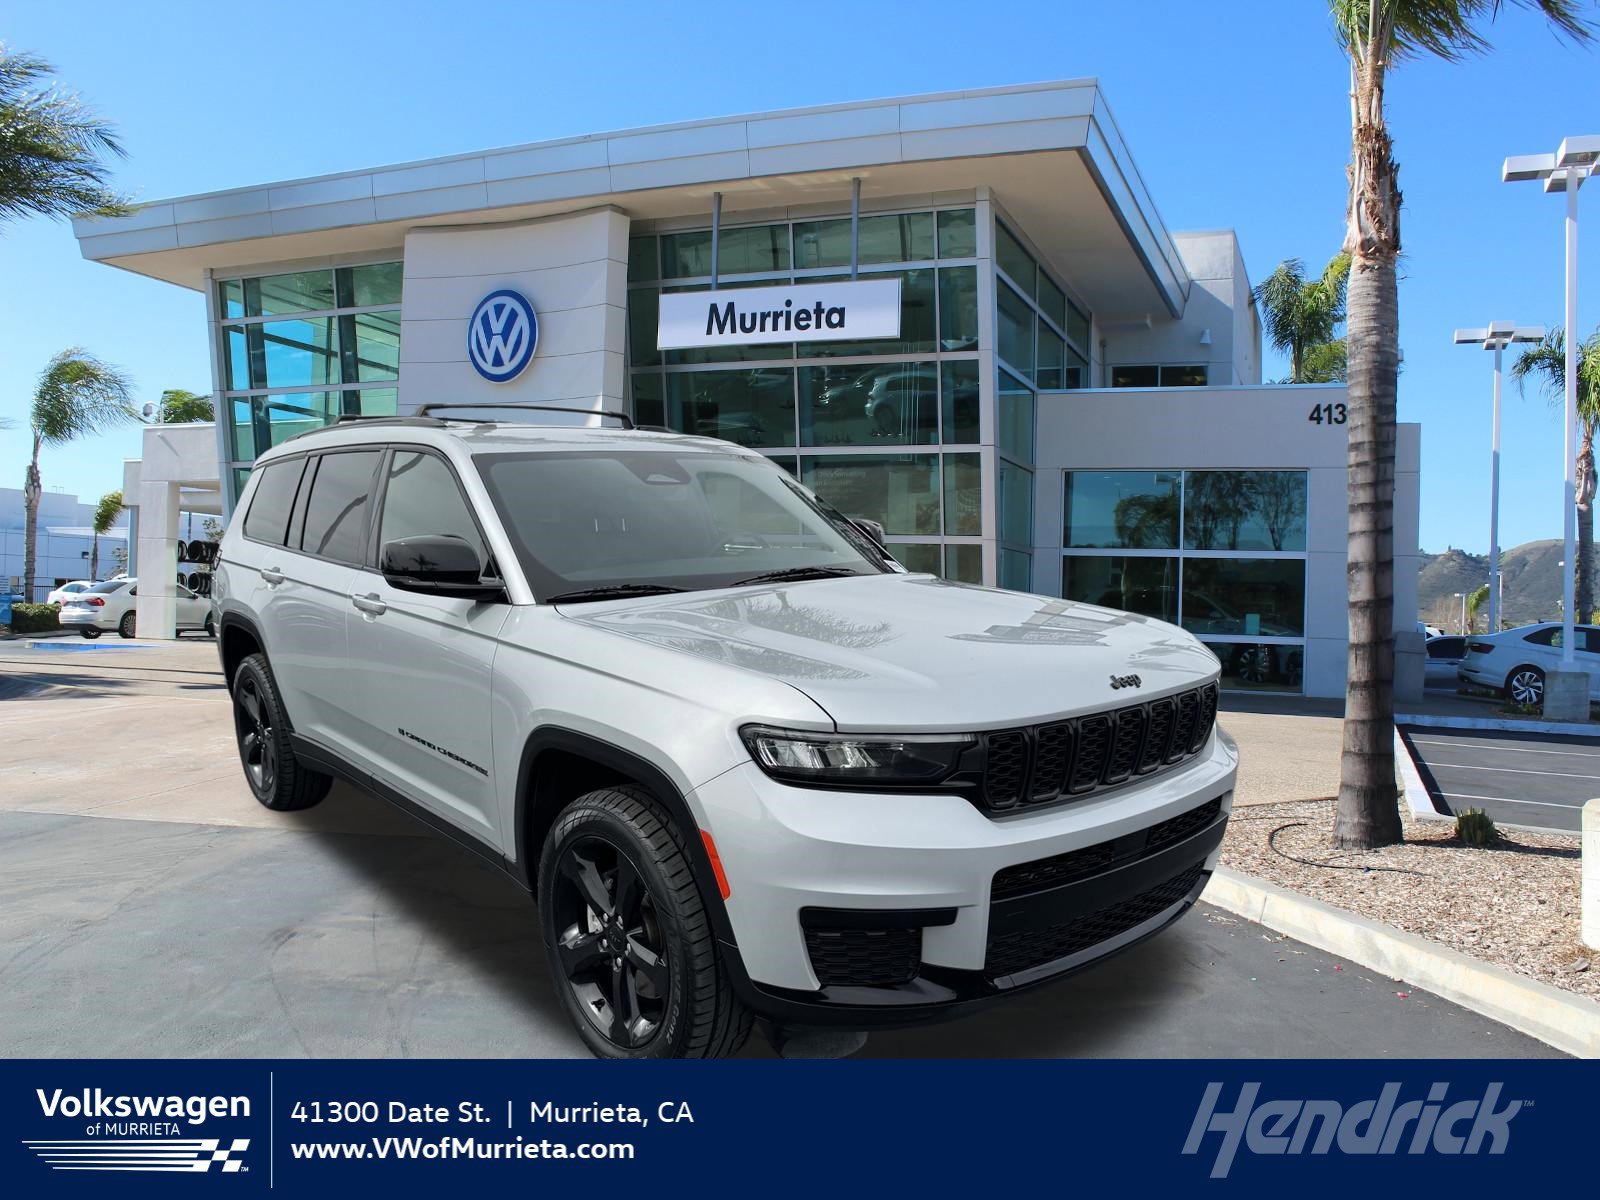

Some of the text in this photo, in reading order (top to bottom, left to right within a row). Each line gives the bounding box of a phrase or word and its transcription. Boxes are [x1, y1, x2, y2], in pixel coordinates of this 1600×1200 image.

[705, 298, 846, 336] Murrieta
[1308, 403, 1347, 425] 413
[1109, 673, 1142, 690] Jeep
